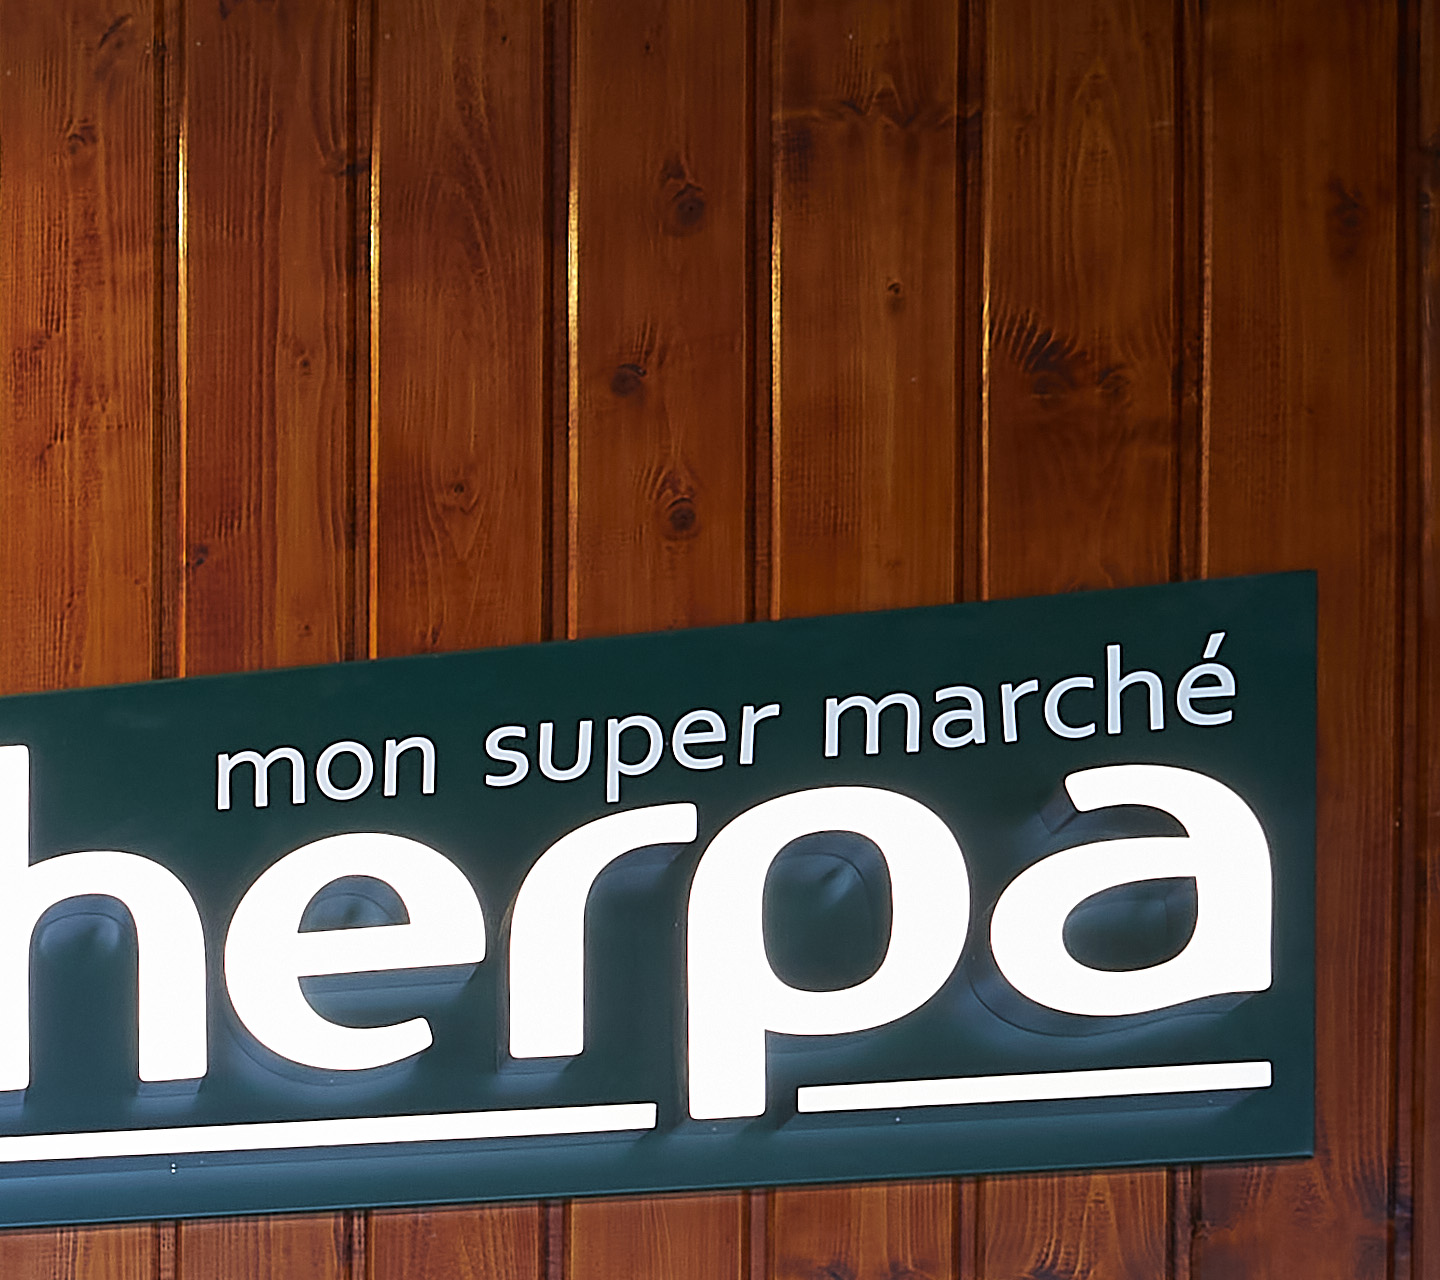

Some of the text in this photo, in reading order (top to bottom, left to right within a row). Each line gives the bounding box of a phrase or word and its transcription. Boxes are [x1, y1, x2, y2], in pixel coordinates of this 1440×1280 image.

[217, 631, 1237, 812] mon super marché
